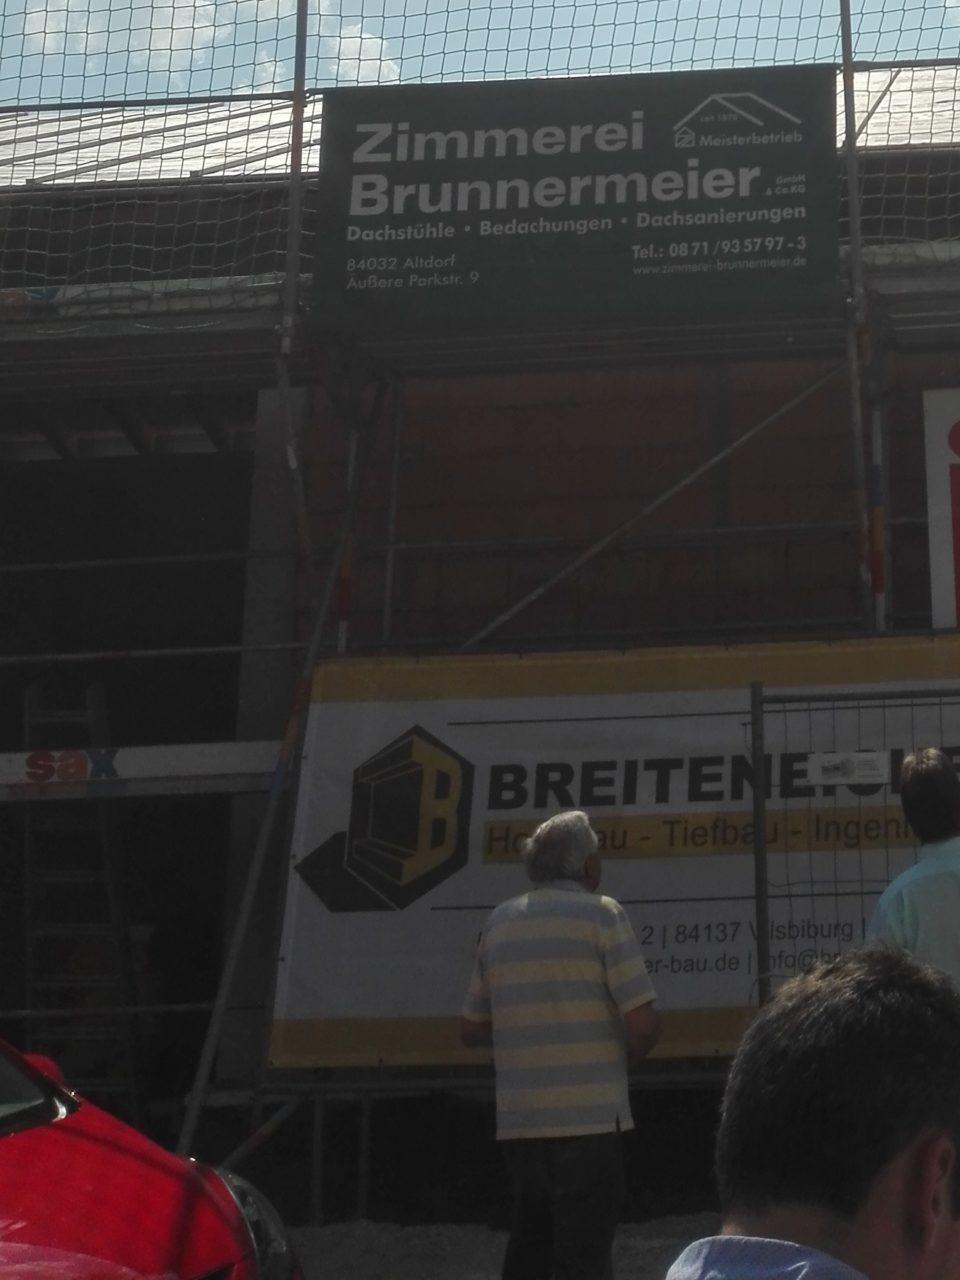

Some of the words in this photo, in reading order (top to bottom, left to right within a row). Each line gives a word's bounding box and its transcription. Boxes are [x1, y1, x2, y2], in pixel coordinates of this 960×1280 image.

[353, 110, 644, 163] Zimmerei
[700, 130, 803, 147] Meisterbetrieb
[350, 158, 761, 215] Brunnermeier
[776, 174, 806, 184] GmbH
[346, 222, 455, 241] Dachstühle
[480, 216, 612, 236] Bedachungen
[636, 206, 806, 228] Dachsanierungen
[632, 244, 663, 259] Tel.:
[346, 257, 398, 271] 84032
[403, 254, 456, 269] Altdorf
[409, 273, 463, 288] Parkstr.
[469, 271, 480, 284] 9
[675, 921, 741, 944] 84137
